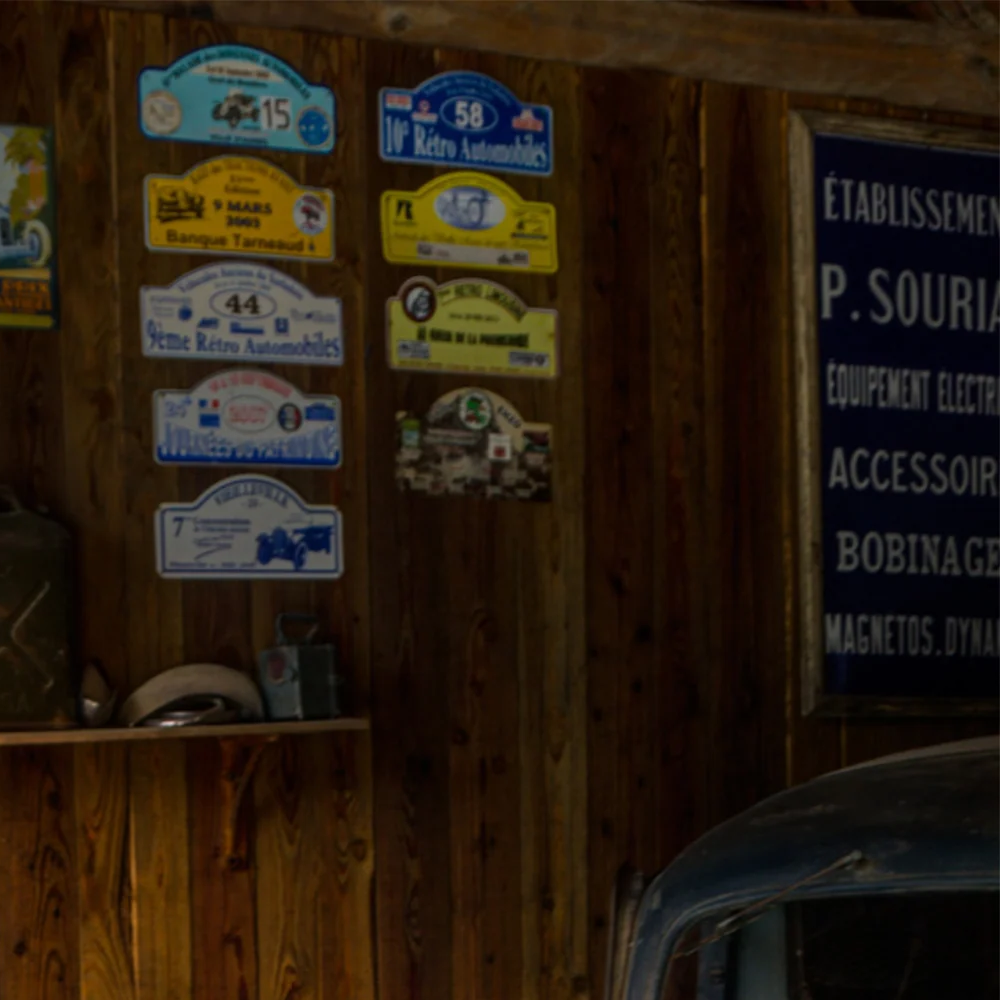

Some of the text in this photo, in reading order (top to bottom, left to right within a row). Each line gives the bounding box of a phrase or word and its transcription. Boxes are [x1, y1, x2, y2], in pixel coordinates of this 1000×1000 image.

[262, 98, 290, 130] 15
[453, 100, 484, 129] 58
[412, 123, 457, 159] Rétro
[460, 133, 548, 169] Automobiles
[227, 201, 272, 214] MARS
[166, 229, 228, 248] Banque
[225, 293, 260, 315] 44
[196, 331, 239, 353] Rétro
[245, 332, 341, 358] Automobiles
